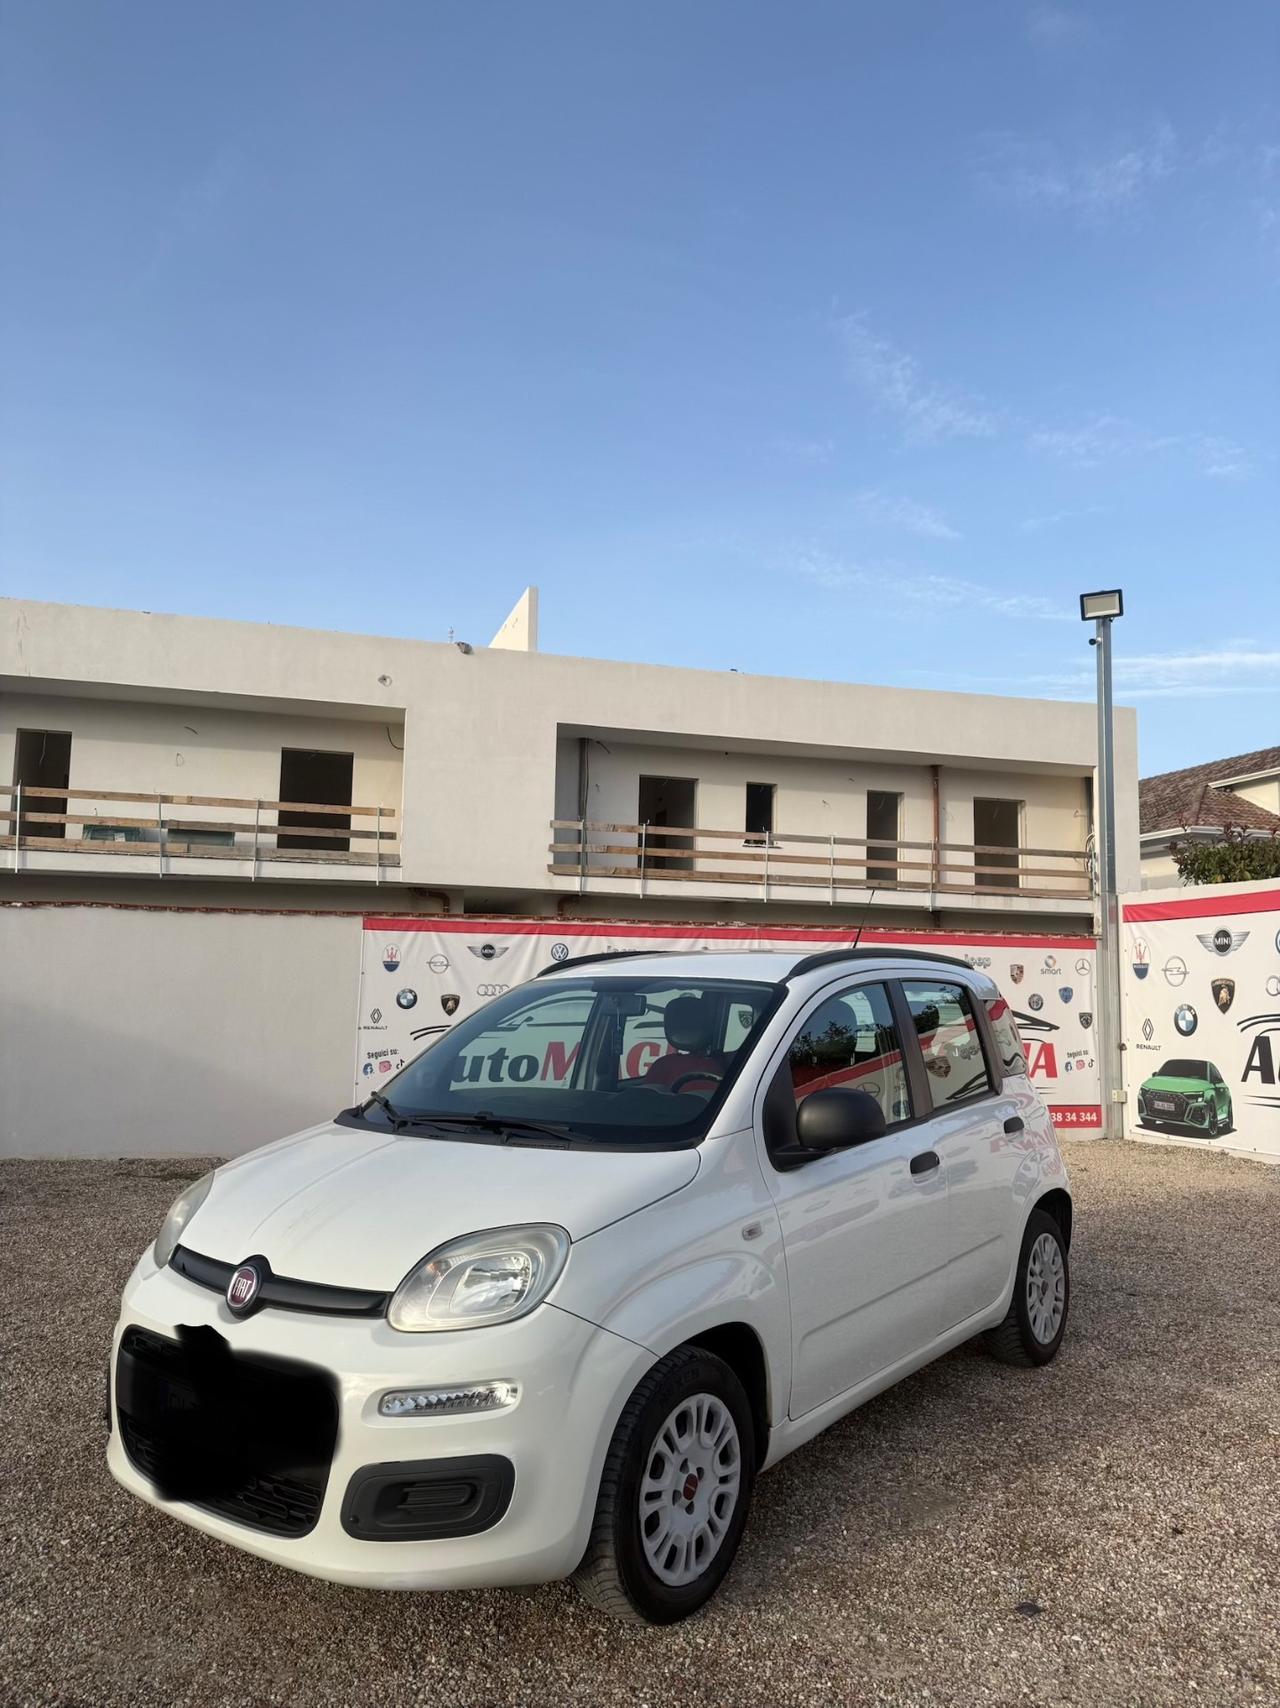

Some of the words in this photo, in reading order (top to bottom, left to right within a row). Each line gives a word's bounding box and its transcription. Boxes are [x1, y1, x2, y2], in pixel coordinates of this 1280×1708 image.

[1215, 937, 1231, 945] MINI
[1065, 1112, 1077, 1122] 34
[1079, 1112, 1098, 1122] 344
[232, 1277, 253, 1298] FIAT
